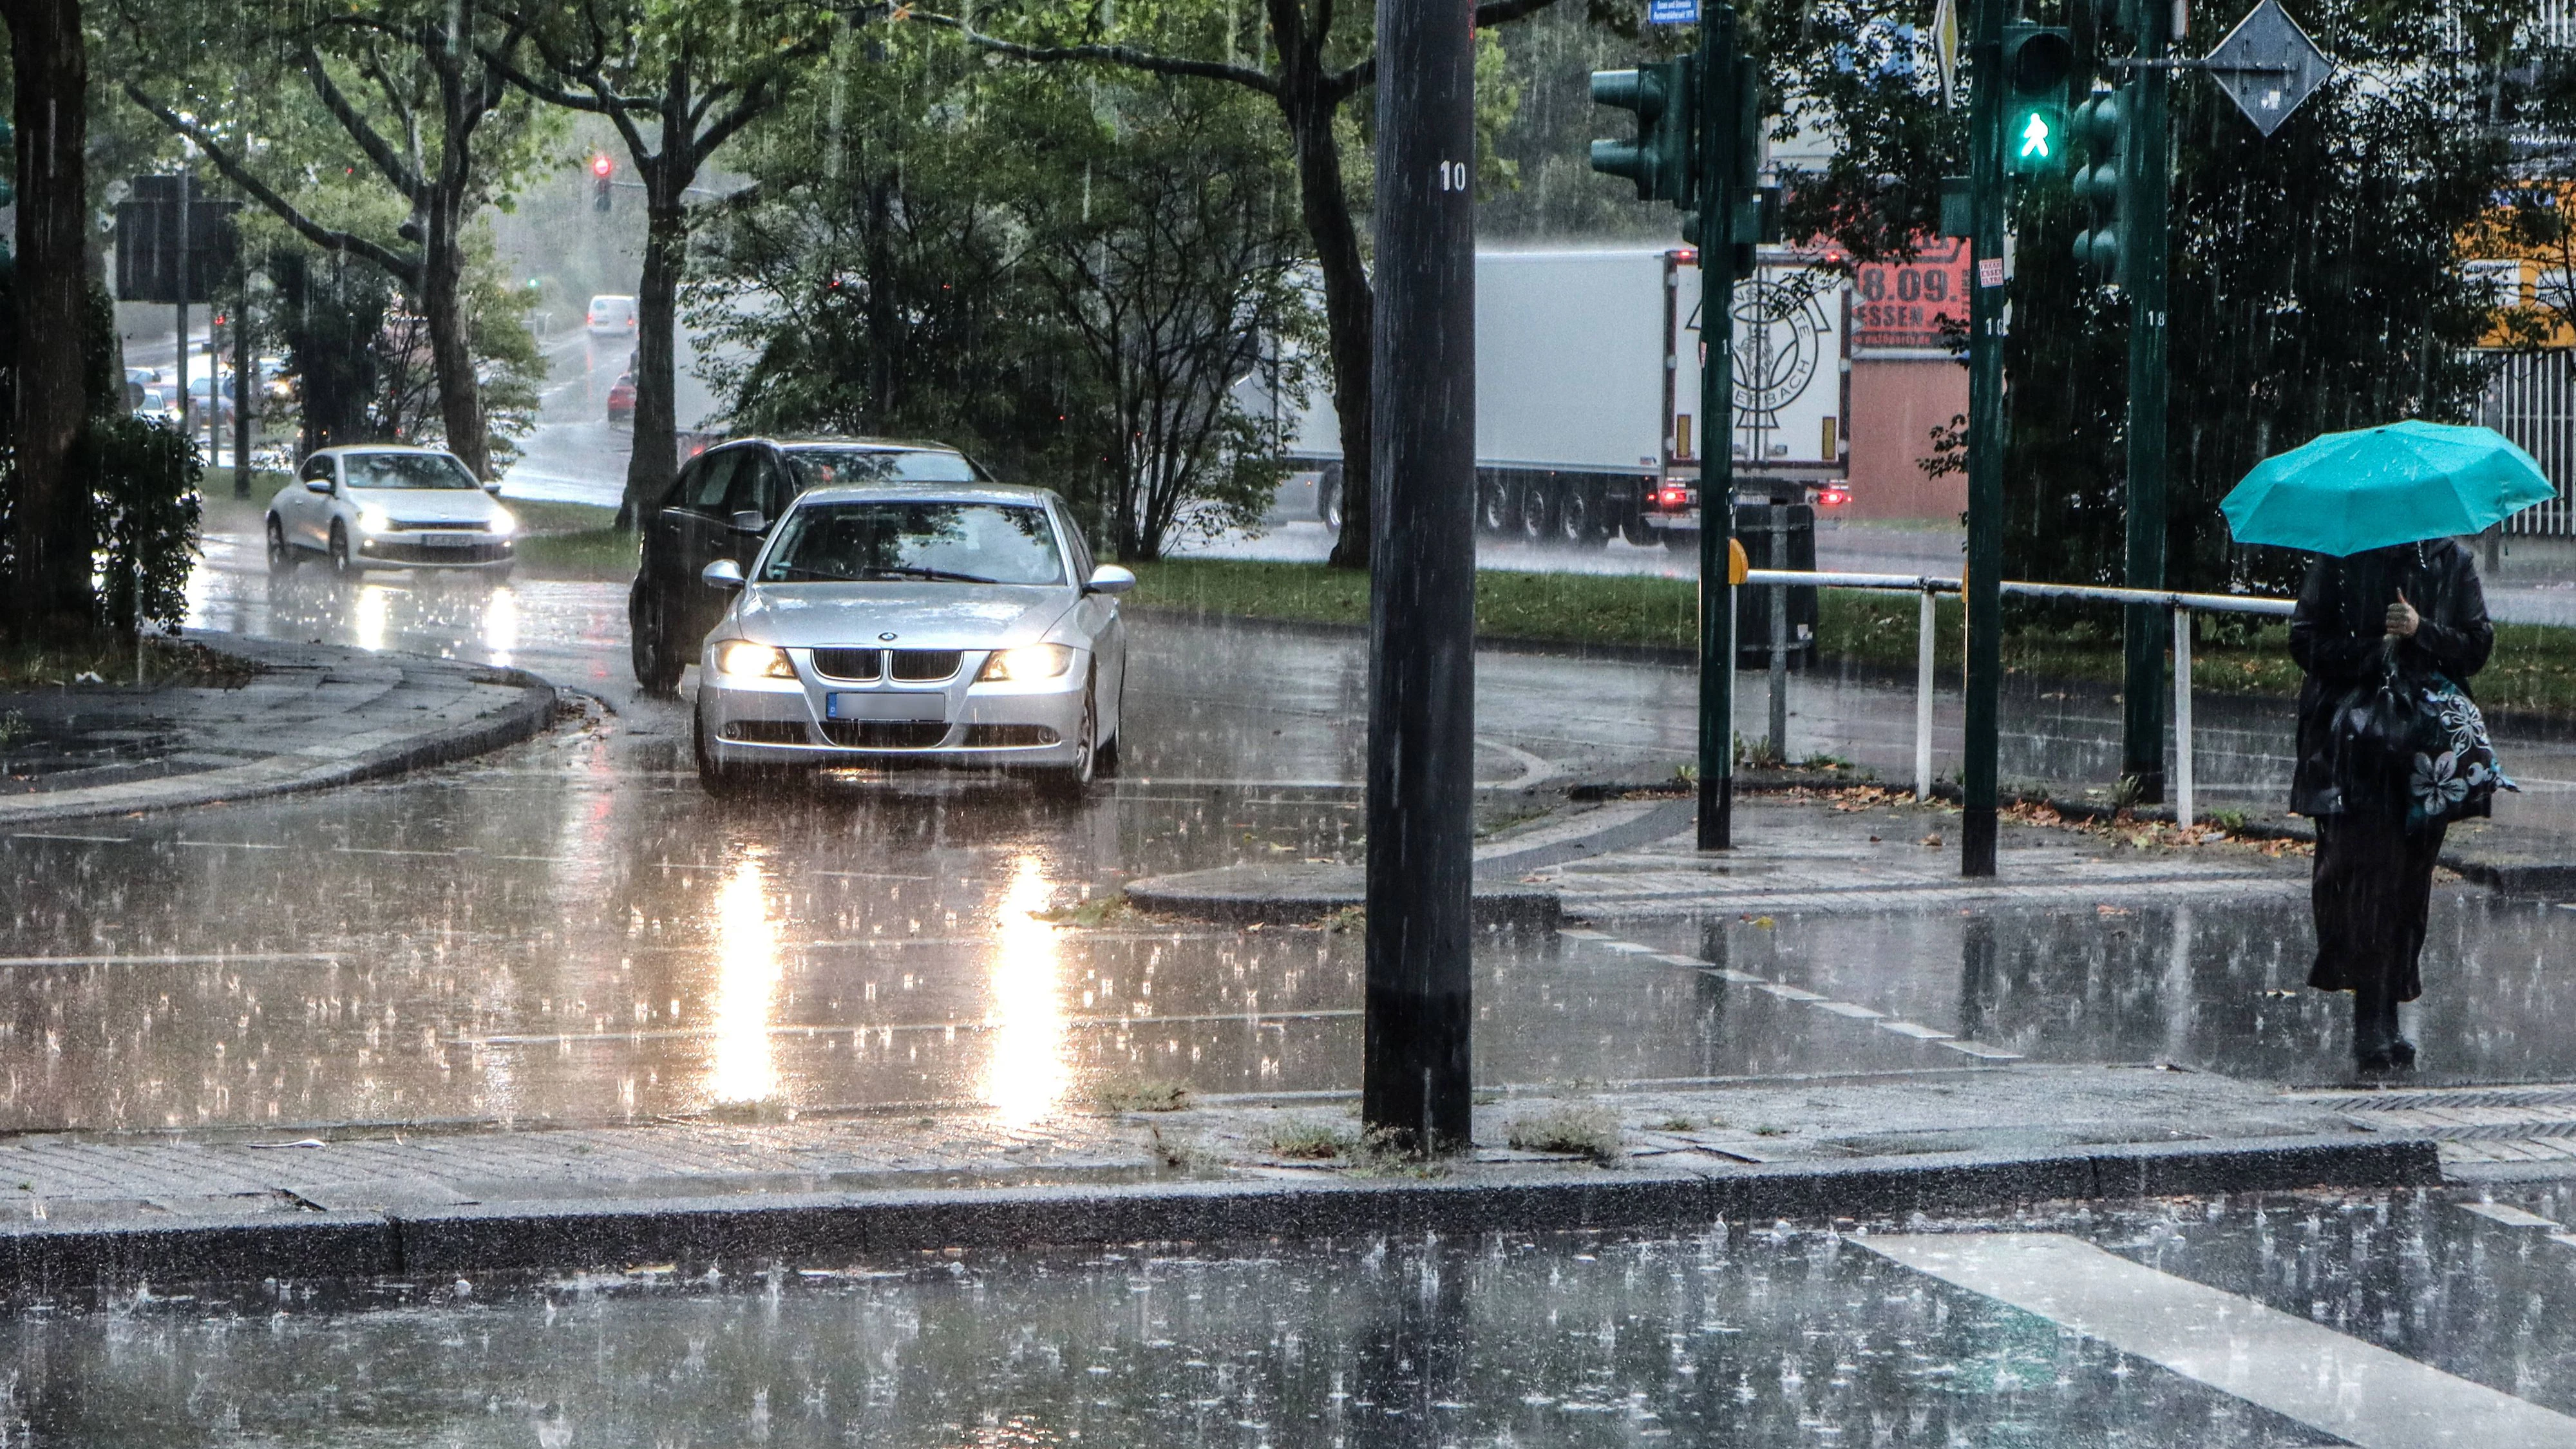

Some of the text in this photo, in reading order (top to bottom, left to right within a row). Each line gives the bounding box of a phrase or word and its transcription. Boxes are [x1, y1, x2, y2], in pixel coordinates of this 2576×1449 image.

[1441, 160, 1466, 191] 10
[1854, 268, 1958, 303] 8.09.
[1857, 305, 1924, 327] ESSEN
[2148, 310, 2164, 327] 18
